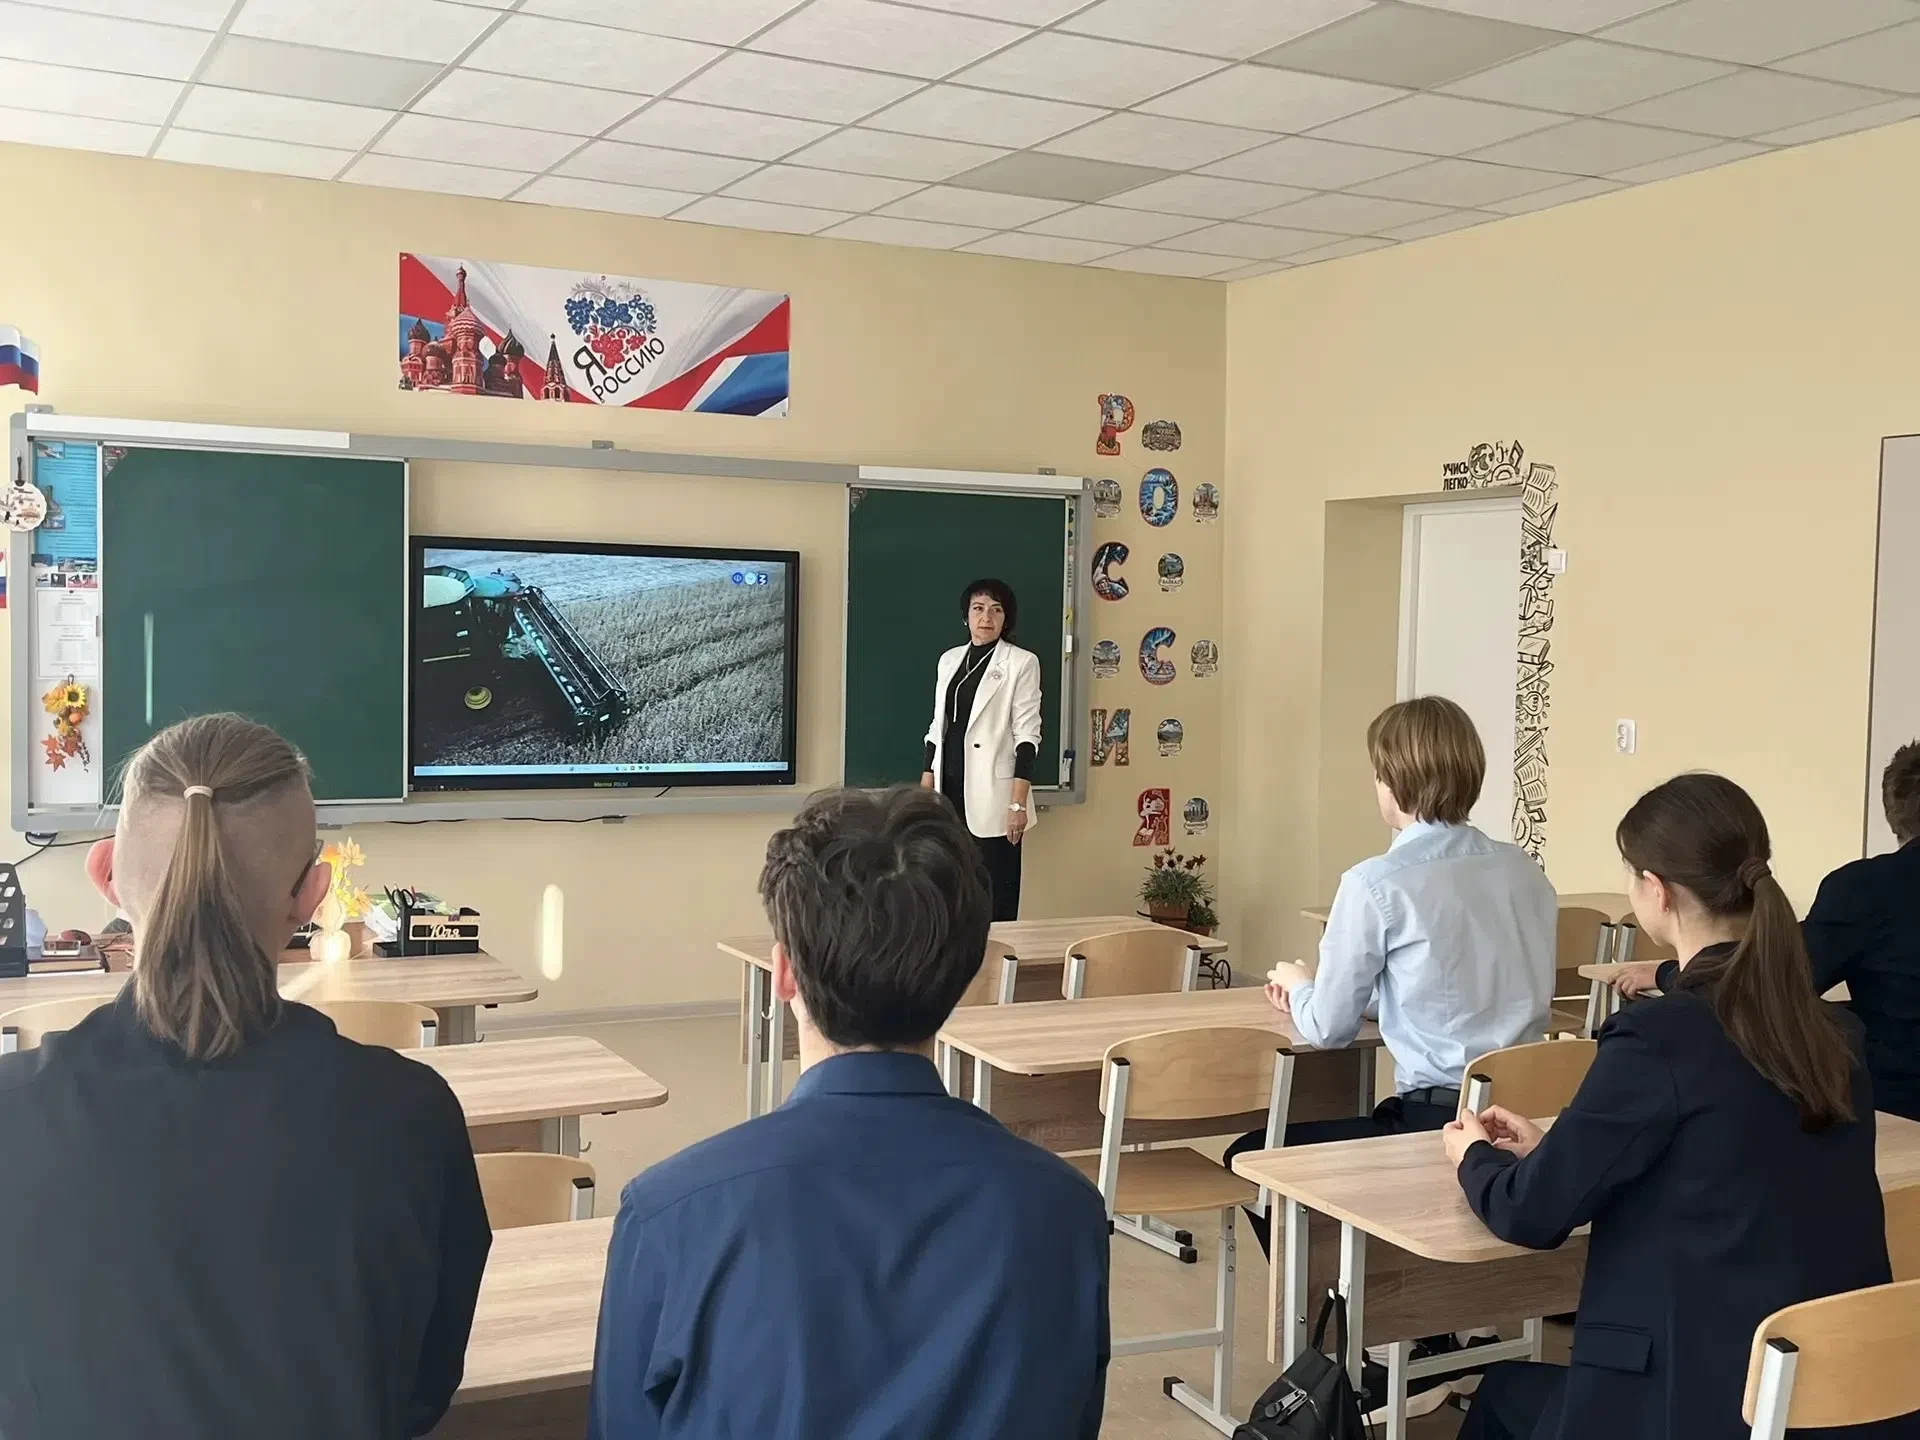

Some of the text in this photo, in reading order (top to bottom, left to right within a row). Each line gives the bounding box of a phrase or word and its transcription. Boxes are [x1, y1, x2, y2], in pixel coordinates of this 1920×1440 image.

[573, 345, 607, 387] Я
[592, 338, 665, 403] РОССИЮ
[1443, 462, 1469, 476] УЧИСЬ
[1443, 477, 1468, 491] ЛЕГКО
[430, 924, 460, 938] Юля
